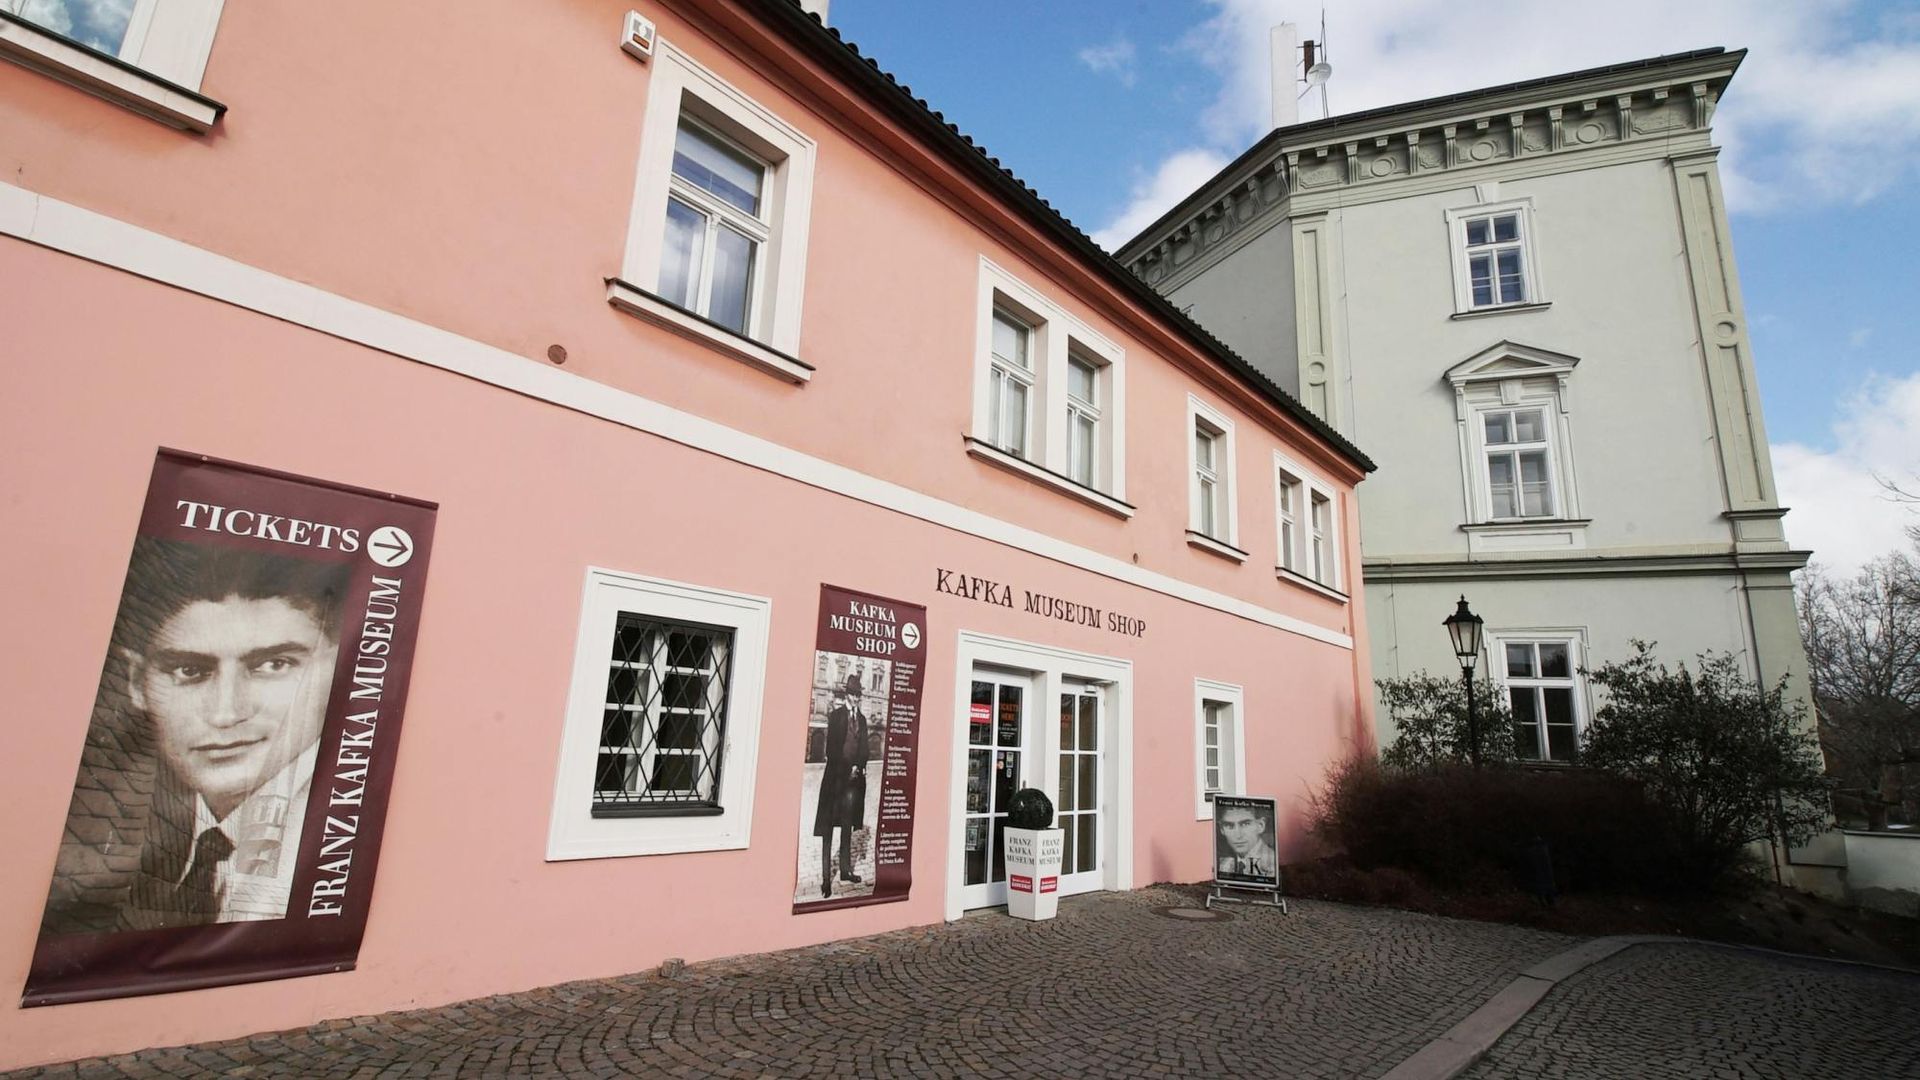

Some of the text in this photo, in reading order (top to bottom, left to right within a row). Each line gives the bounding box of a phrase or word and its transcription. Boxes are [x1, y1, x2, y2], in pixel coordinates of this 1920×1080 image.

[177, 500, 361, 553] TICKETS
[850, 600, 896, 623] KAFKA
[936, 568, 1146, 638] KAFKA MUSEUM SHOP
[830, 614, 896, 639] MUSEUM
[856, 636, 896, 655] SHOP
[308, 575, 402, 918] FRANZ KAFKA MUSEUM
[1008, 846, 1032, 856] KAFKA
[1009, 837, 1032, 847] FRANZ
[1041, 848, 1060, 856] KAFKA
[1006, 854, 1035, 866] MUSEUM
